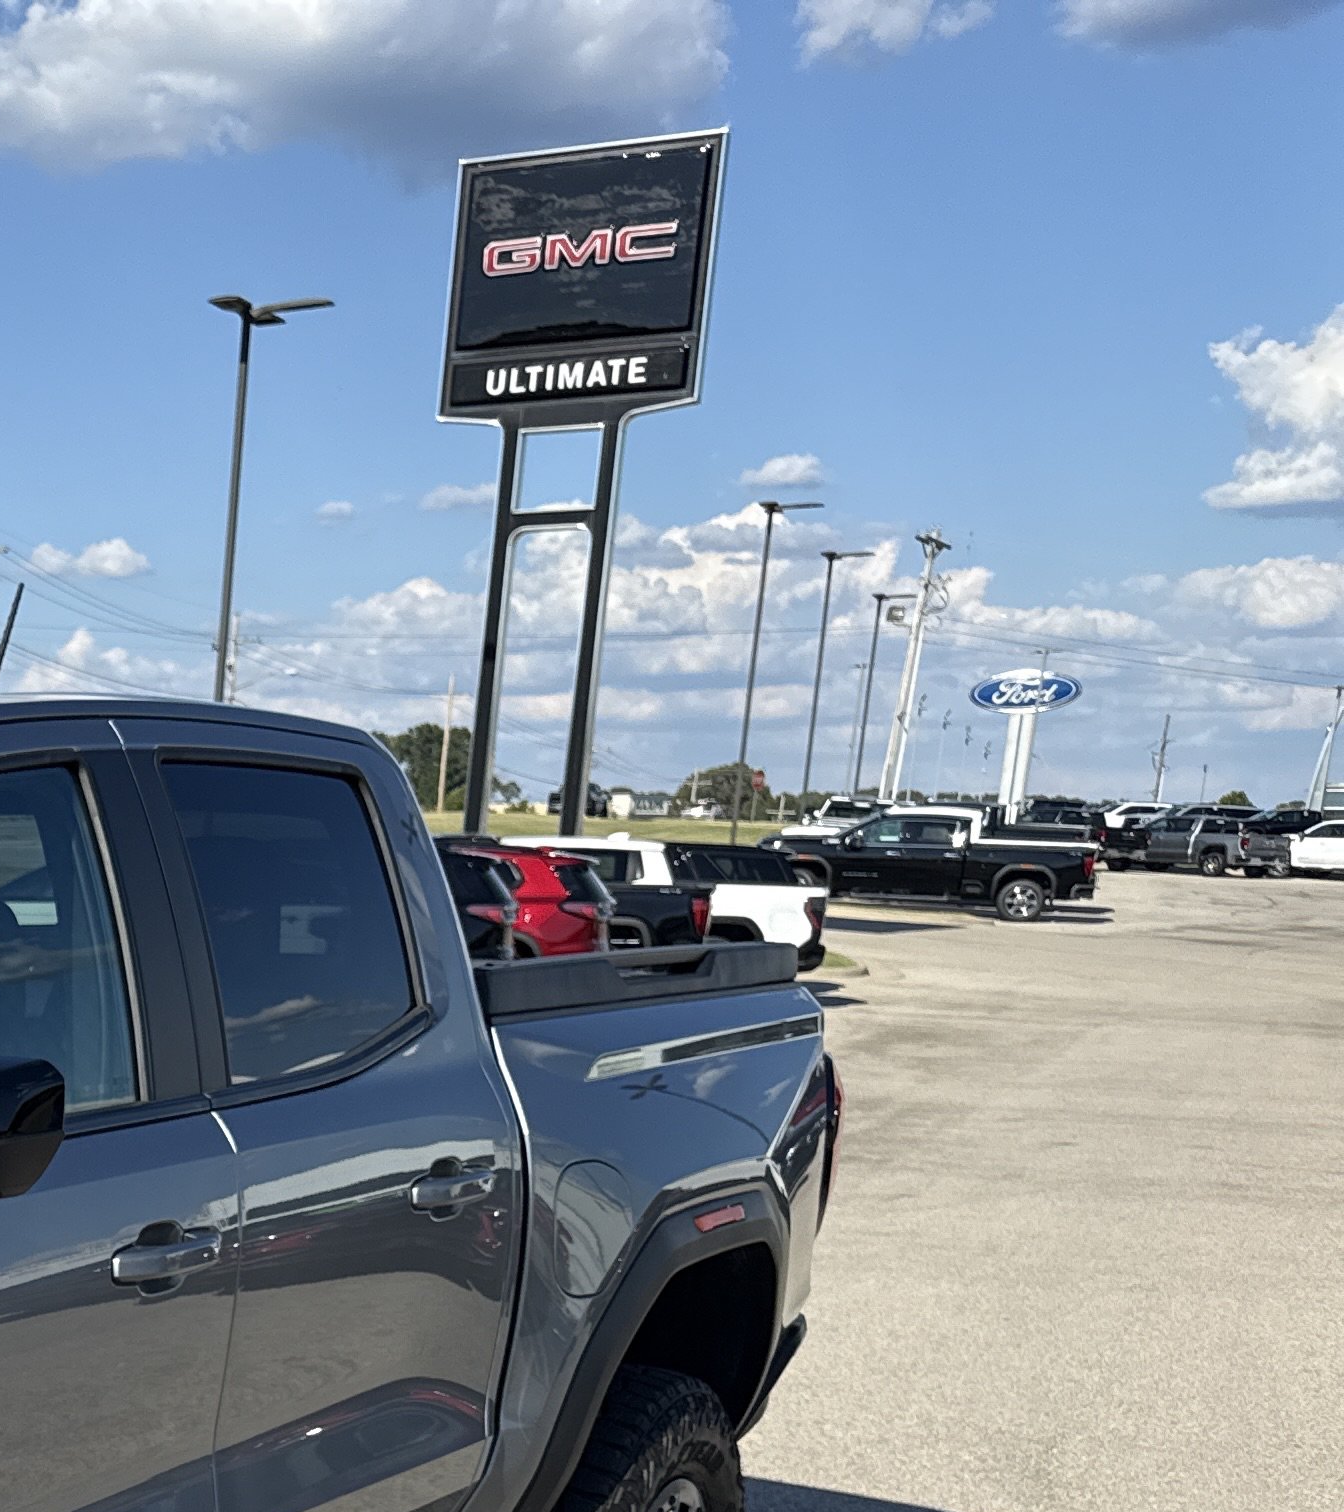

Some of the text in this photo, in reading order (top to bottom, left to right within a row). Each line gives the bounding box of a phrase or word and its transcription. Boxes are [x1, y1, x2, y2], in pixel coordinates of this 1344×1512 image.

[482, 218, 680, 278] GMC
[485, 356, 649, 396] ULTIMATE
[992, 678, 1059, 704] Ford
